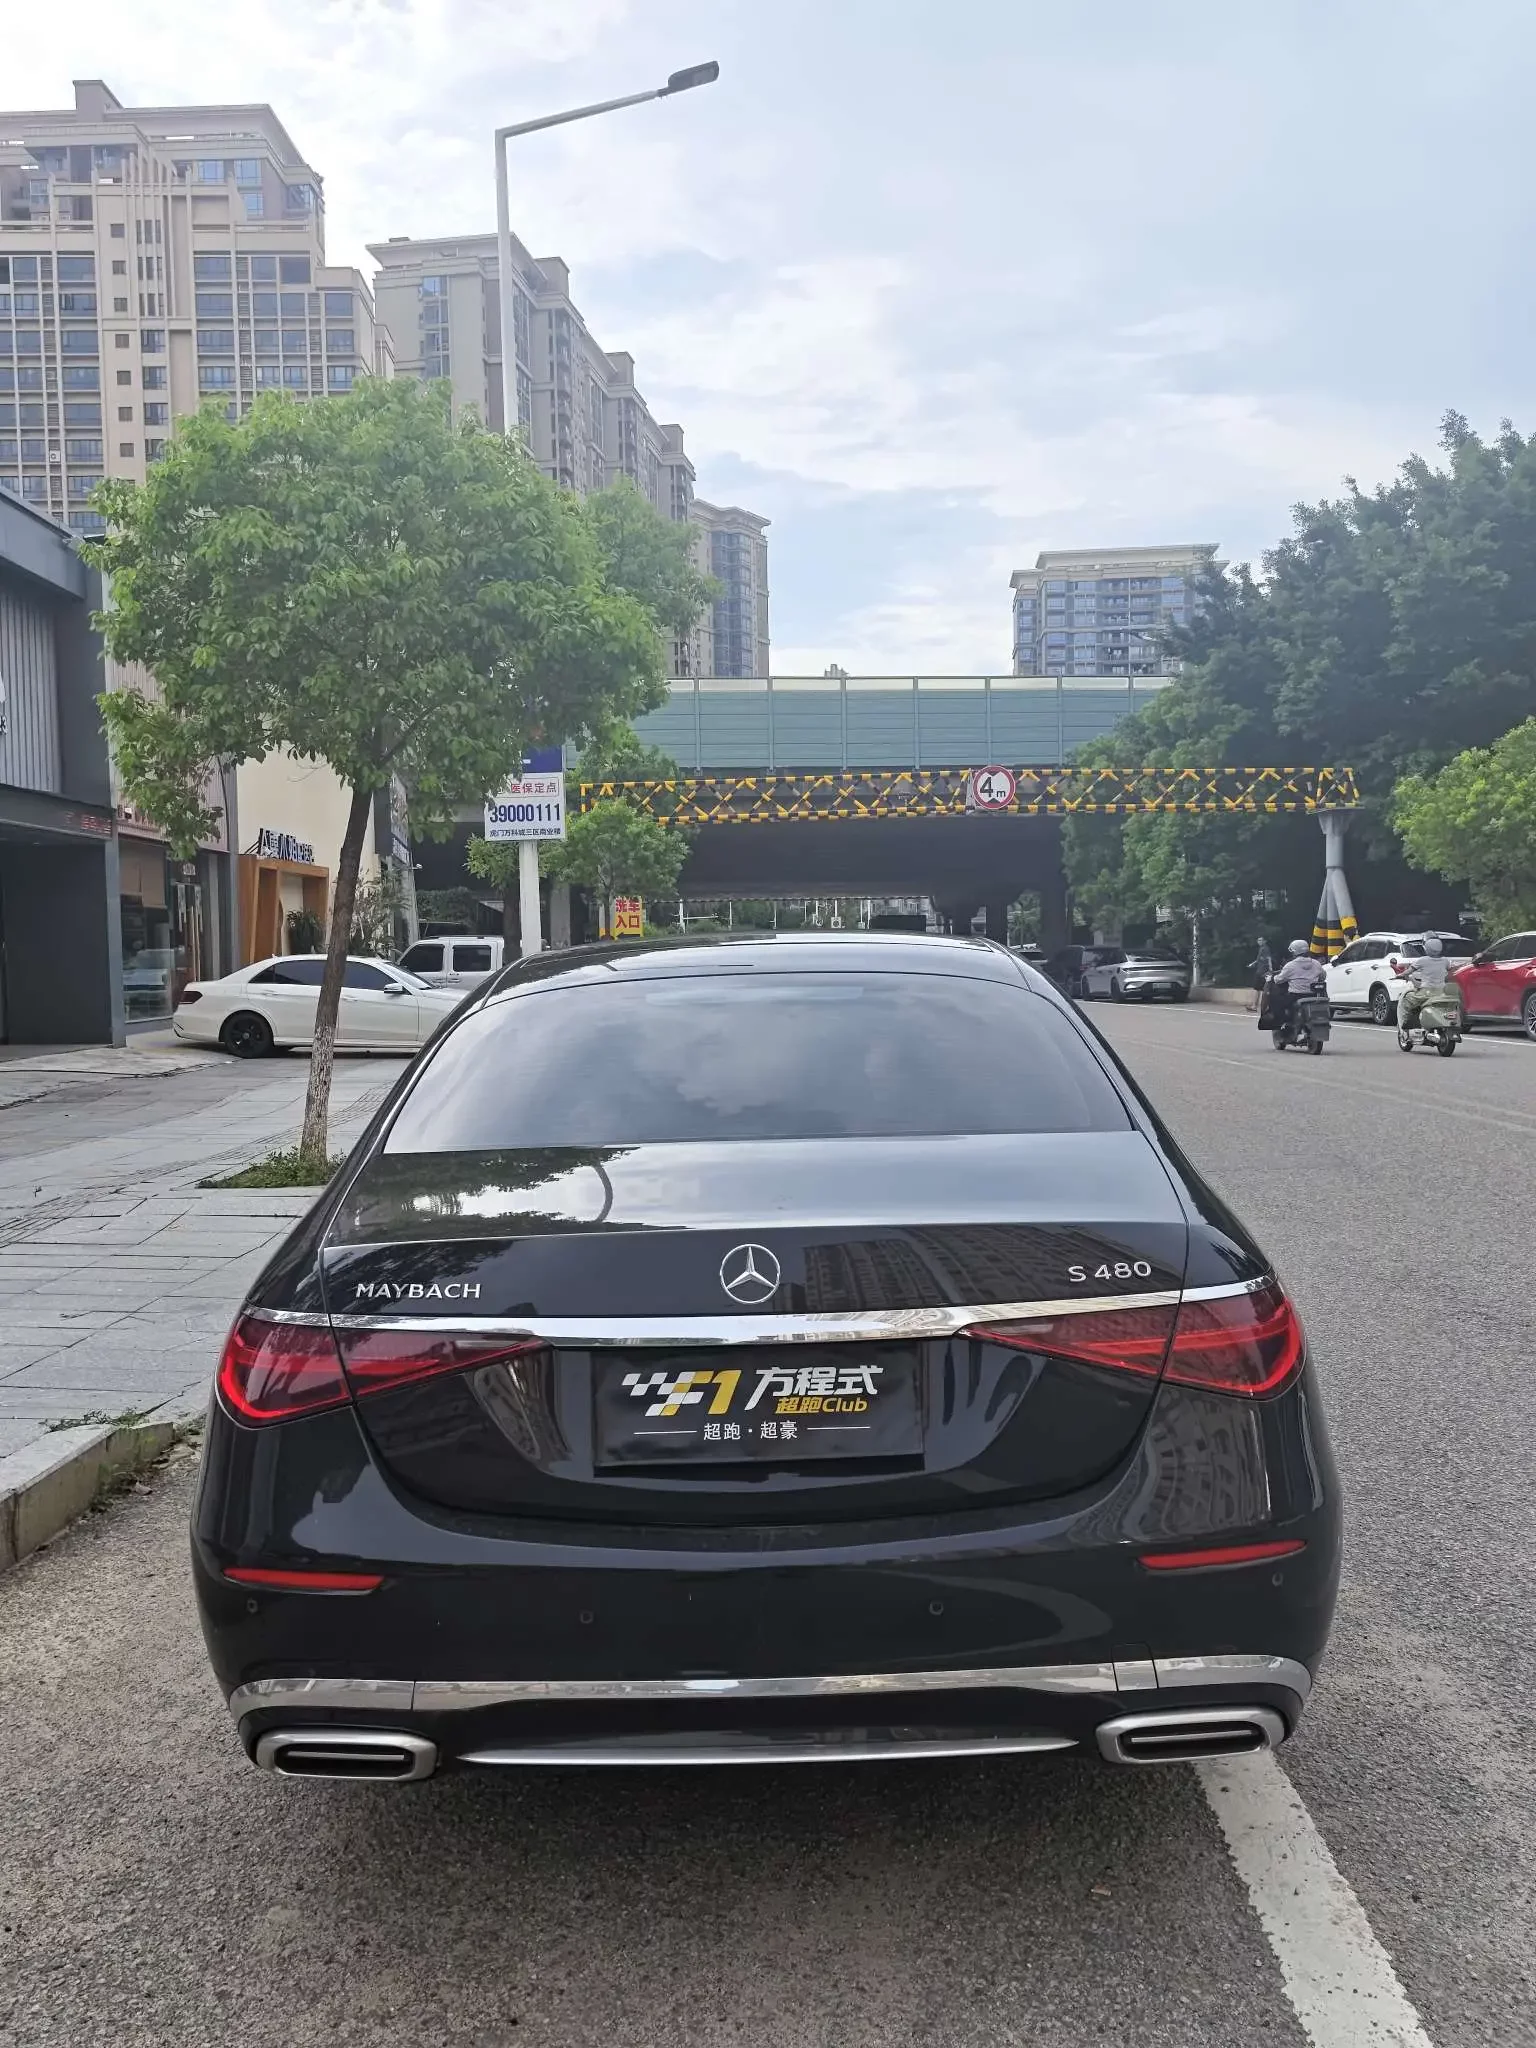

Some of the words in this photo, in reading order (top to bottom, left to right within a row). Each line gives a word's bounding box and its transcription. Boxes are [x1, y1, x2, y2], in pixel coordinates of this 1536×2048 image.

[511, 782, 557, 794] 医保定点
[980, 776, 1006, 798] 4m
[489, 803, 561, 823] 39000111
[615, 915, 640, 928] 入口
[1068, 1265, 1087, 1282] S
[1094, 1261, 1152, 1280] 480
[355, 1283, 482, 1299] MAYBACH
[744, 1366, 884, 1411] 方程式
